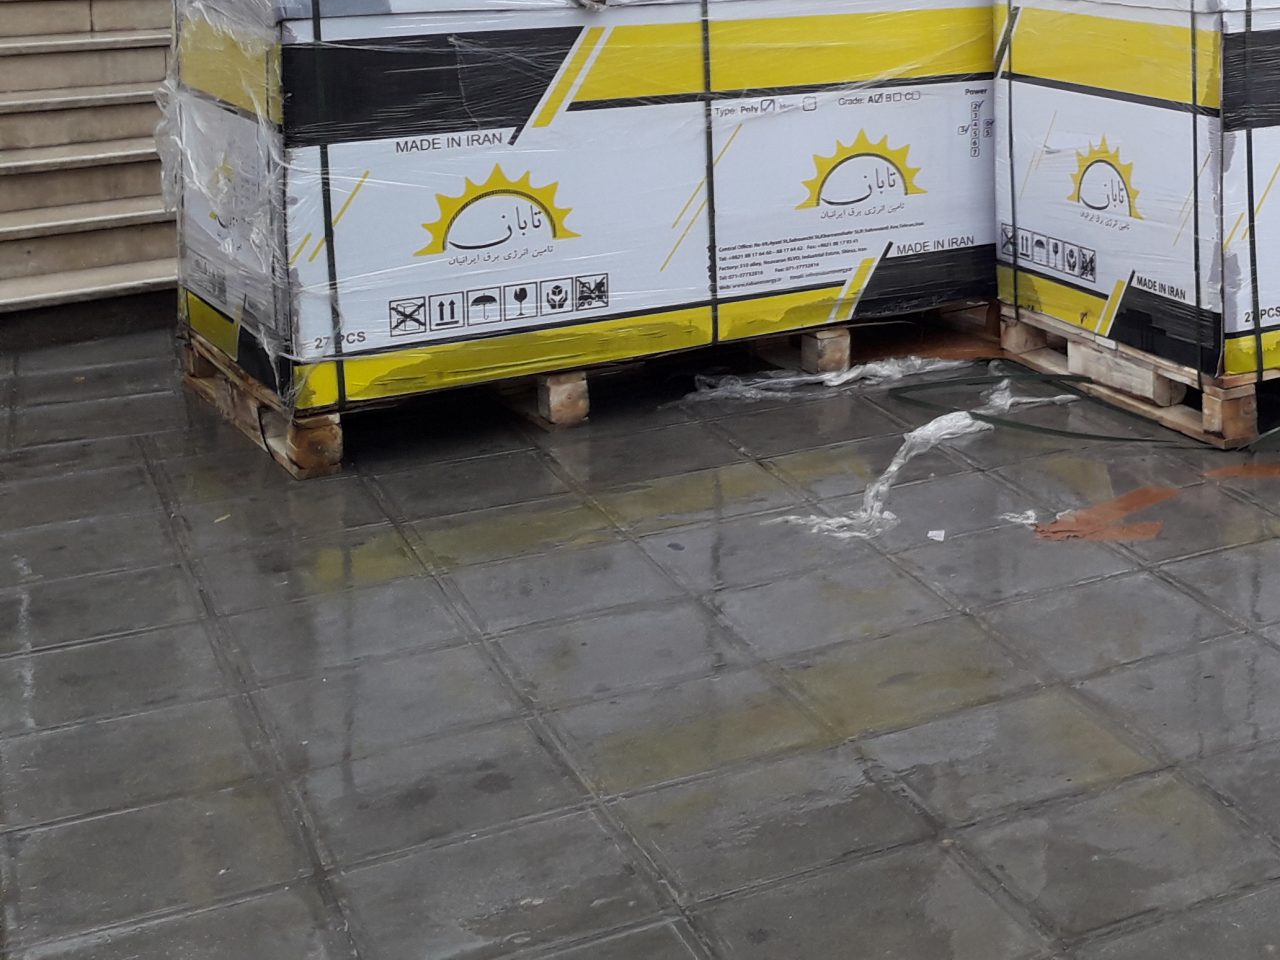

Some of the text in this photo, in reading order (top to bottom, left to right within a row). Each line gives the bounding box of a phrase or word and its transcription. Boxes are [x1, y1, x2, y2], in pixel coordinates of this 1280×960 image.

[965, 88, 988, 96] Power
[395, 132, 502, 153] MADE IN IRAN
[821, 166, 896, 206] تابان
[1080, 178, 1124, 210] تابان
[448, 205, 543, 250] تابان
[896, 235, 974, 255] MADE IN IRAN
[483, 252, 500, 262] برق
[1137, 275, 1186, 301] MADE IN IRAN
